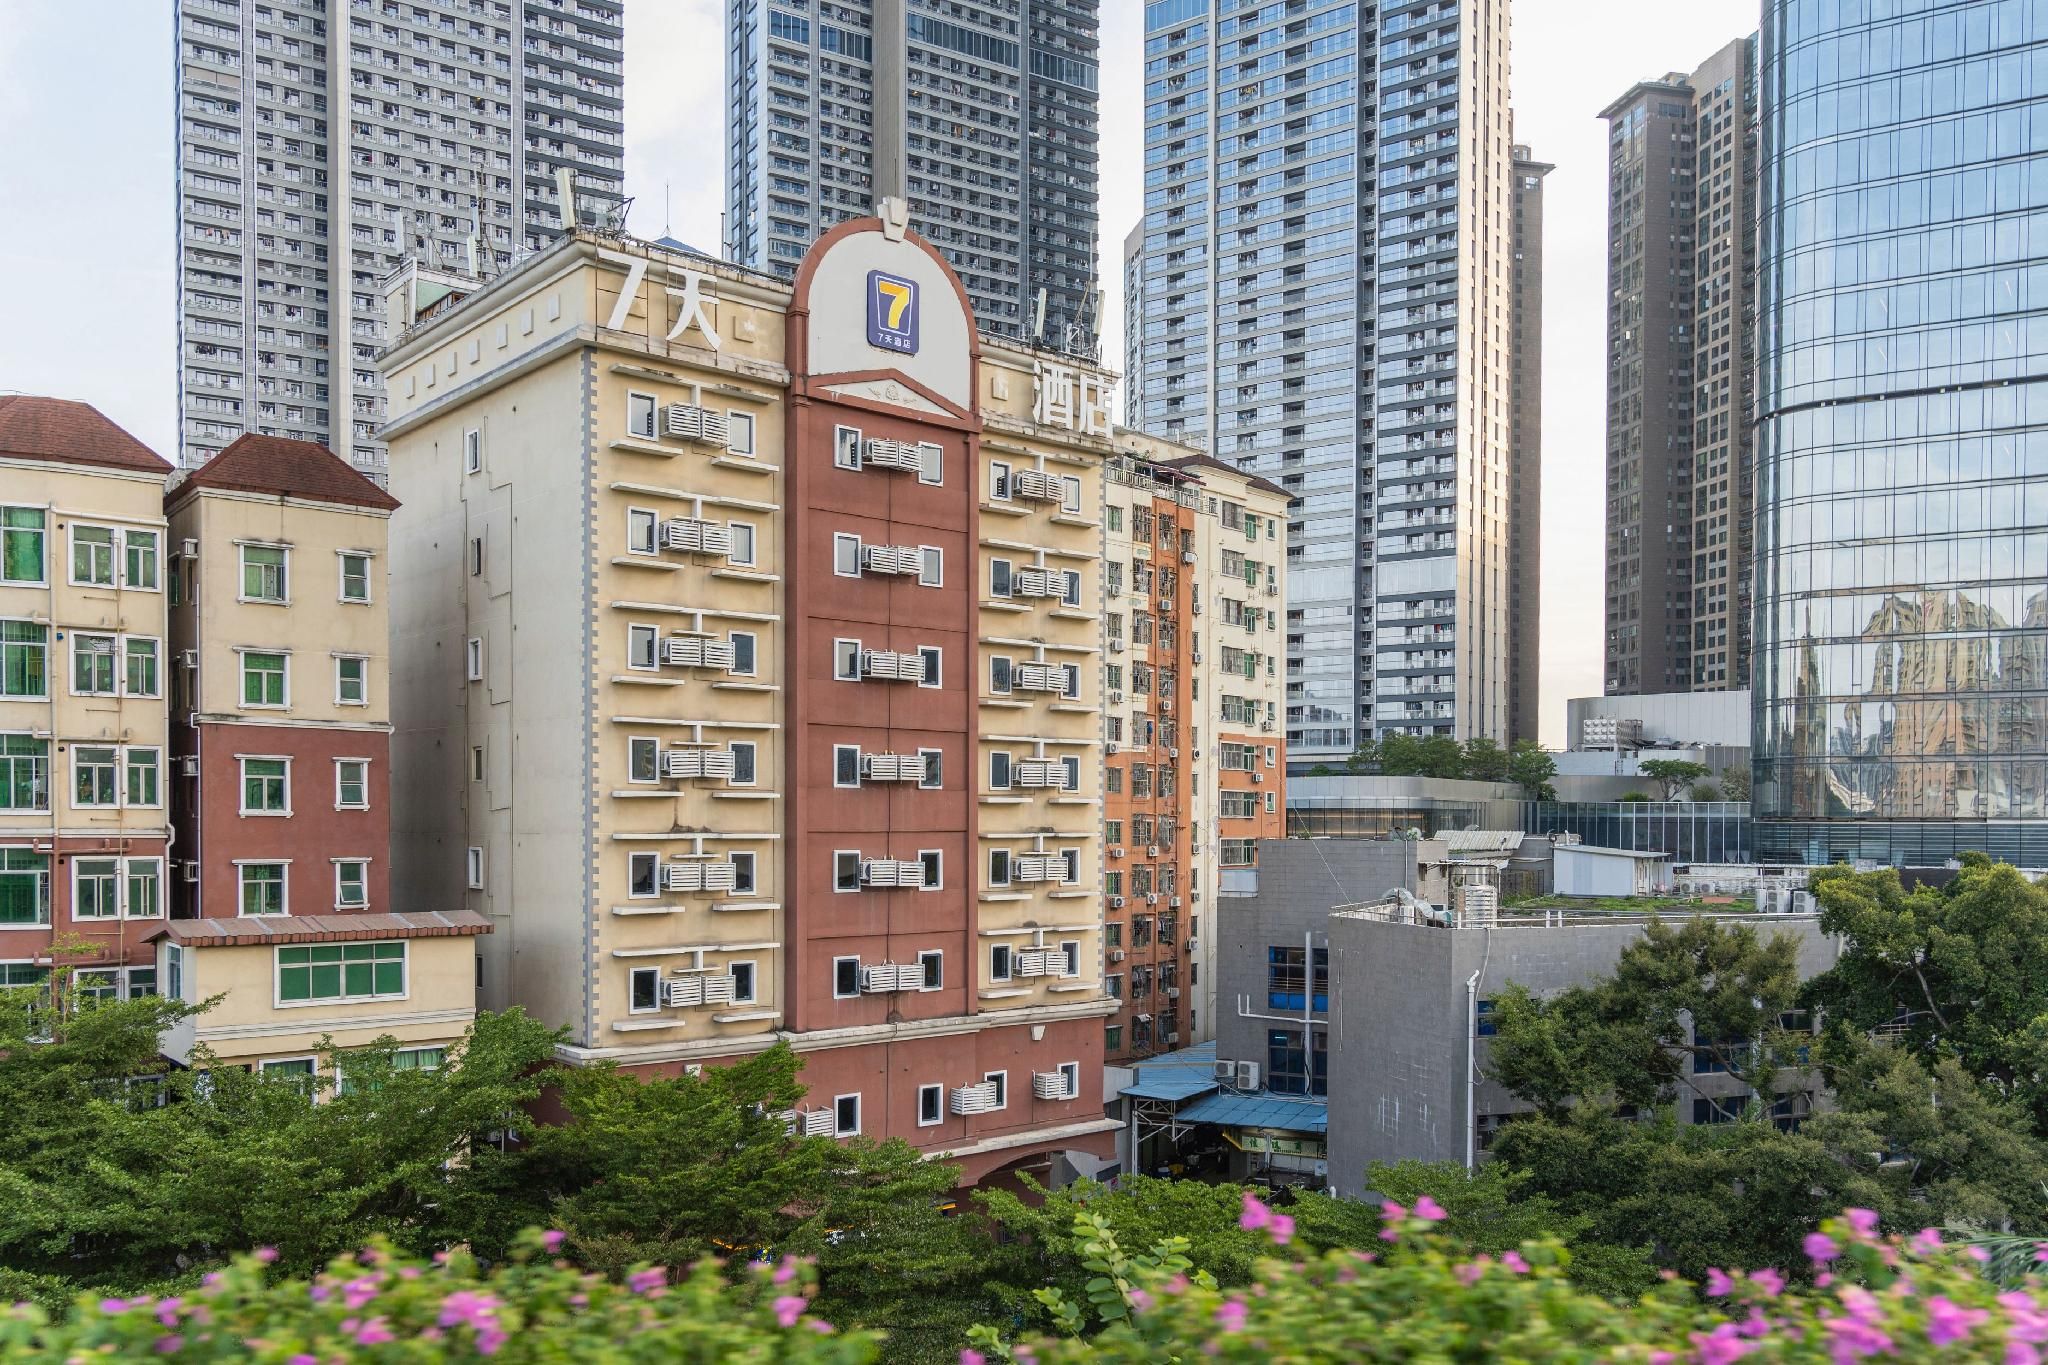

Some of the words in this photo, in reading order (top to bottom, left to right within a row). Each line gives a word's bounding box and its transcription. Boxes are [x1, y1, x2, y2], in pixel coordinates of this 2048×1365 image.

[597, 247, 721, 350] 7天
[879, 280, 910, 330] 7
[877, 332, 911, 349] 7天酒店
[1032, 360, 1116, 439] 酒店
